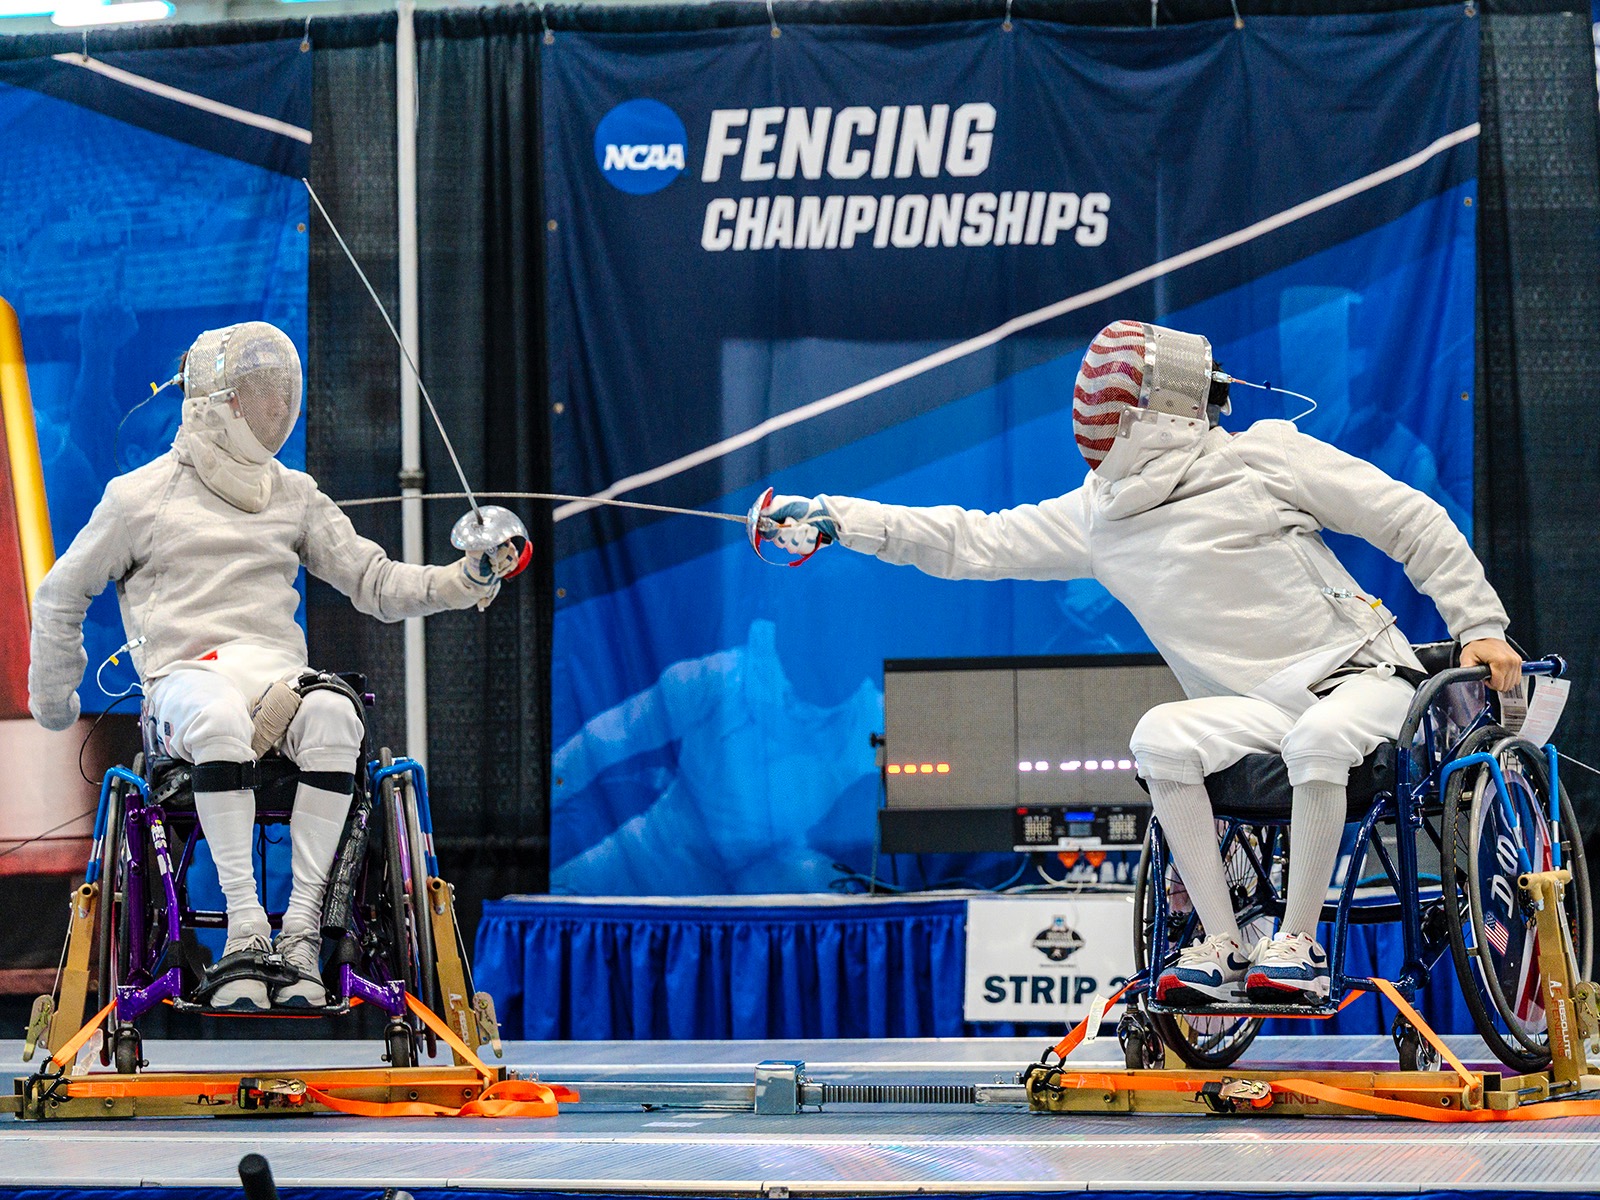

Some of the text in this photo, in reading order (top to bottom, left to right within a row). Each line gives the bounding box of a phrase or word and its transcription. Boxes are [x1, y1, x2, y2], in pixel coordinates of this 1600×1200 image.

[603, 143, 685, 171] NCAA
[701, 102, 997, 183] FENCING
[701, 190, 1111, 251] CHAMPIONSHIPS
[983, 974, 1097, 1005] STRIP
[1558, 999, 1572, 1060] ABSOLUTE
